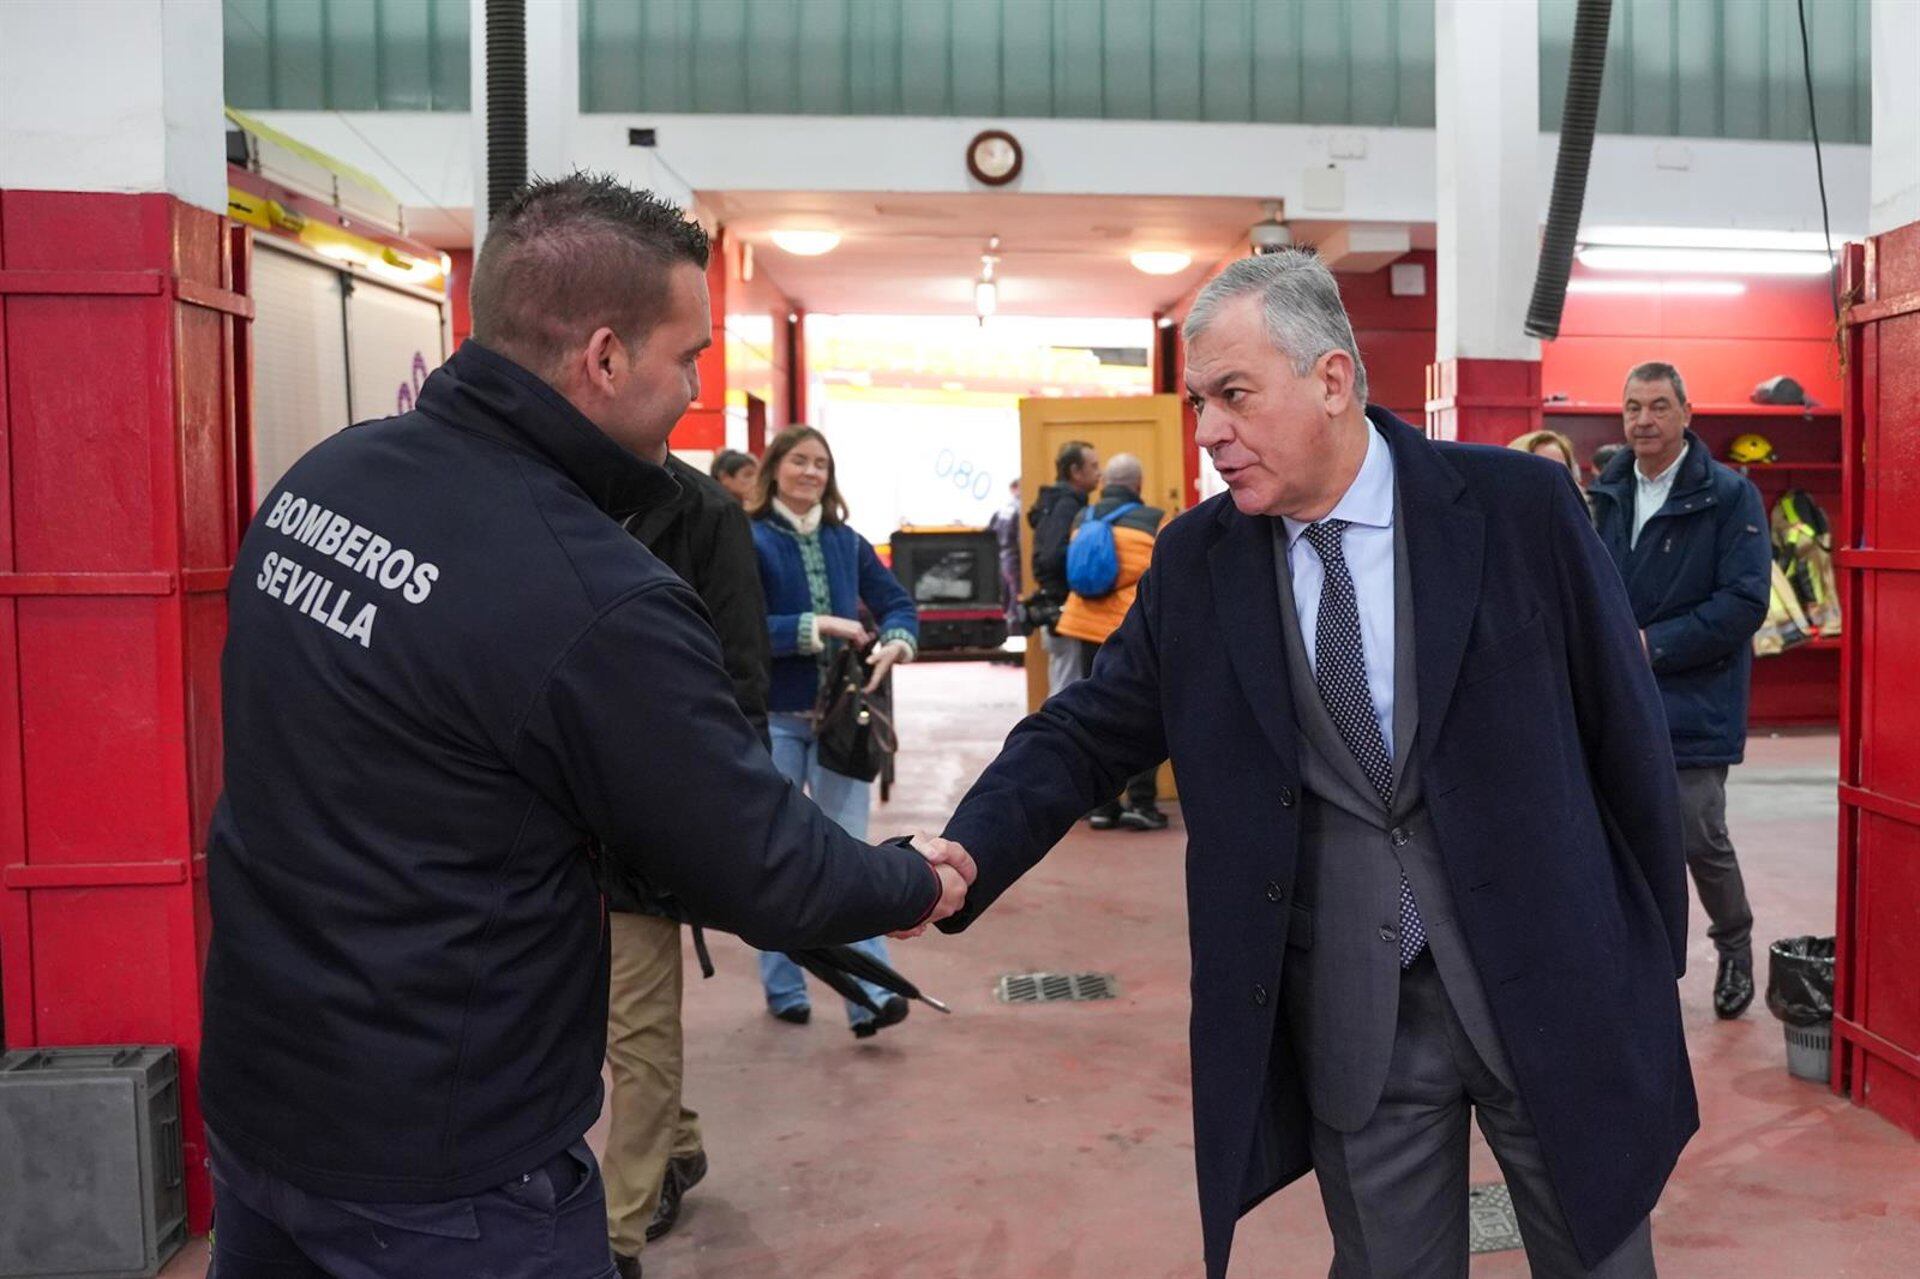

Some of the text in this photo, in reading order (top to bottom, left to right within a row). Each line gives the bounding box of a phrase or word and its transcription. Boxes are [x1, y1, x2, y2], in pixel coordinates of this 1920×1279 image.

[935, 448, 992, 500] 080
[265, 491, 440, 604] BOMBEROS
[256, 551, 379, 648] SEVILLA
